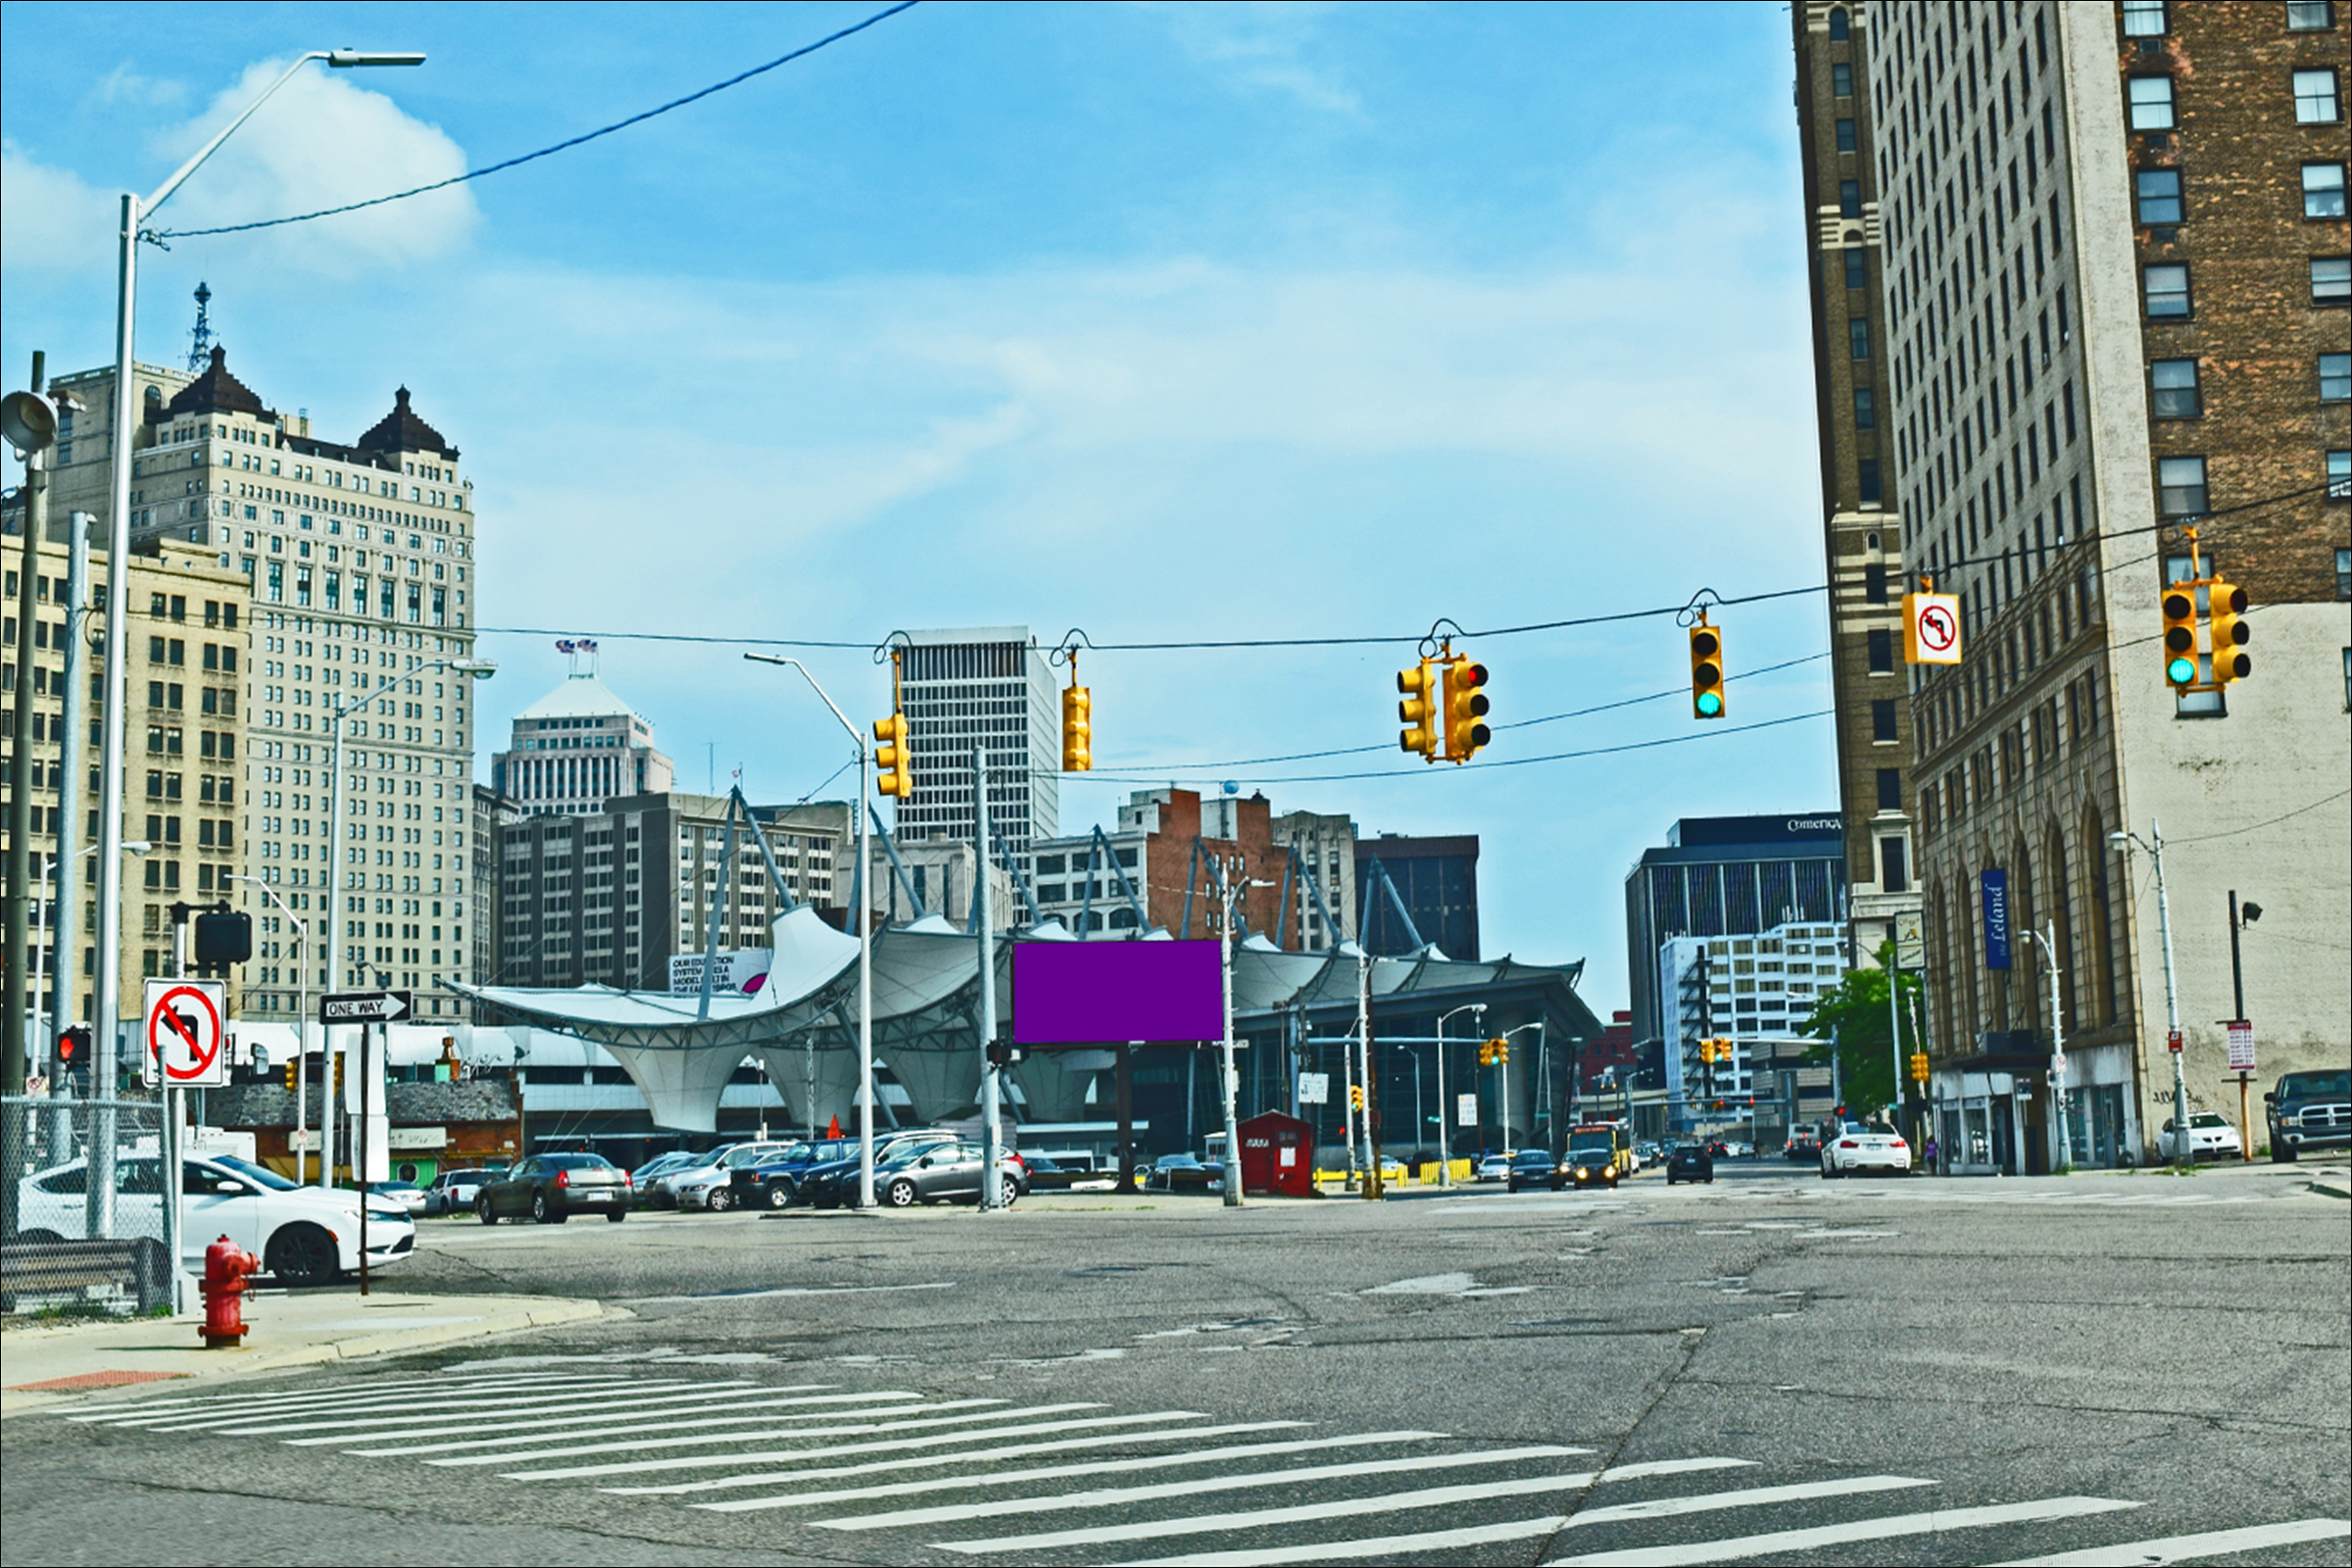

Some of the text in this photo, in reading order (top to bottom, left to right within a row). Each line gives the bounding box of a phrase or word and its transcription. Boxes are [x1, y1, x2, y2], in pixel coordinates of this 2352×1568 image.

[1984, 883, 2006, 942] Leland
[691, 956, 735, 966] EDUTION
[329, 1001, 383, 1015] ONE WAY
